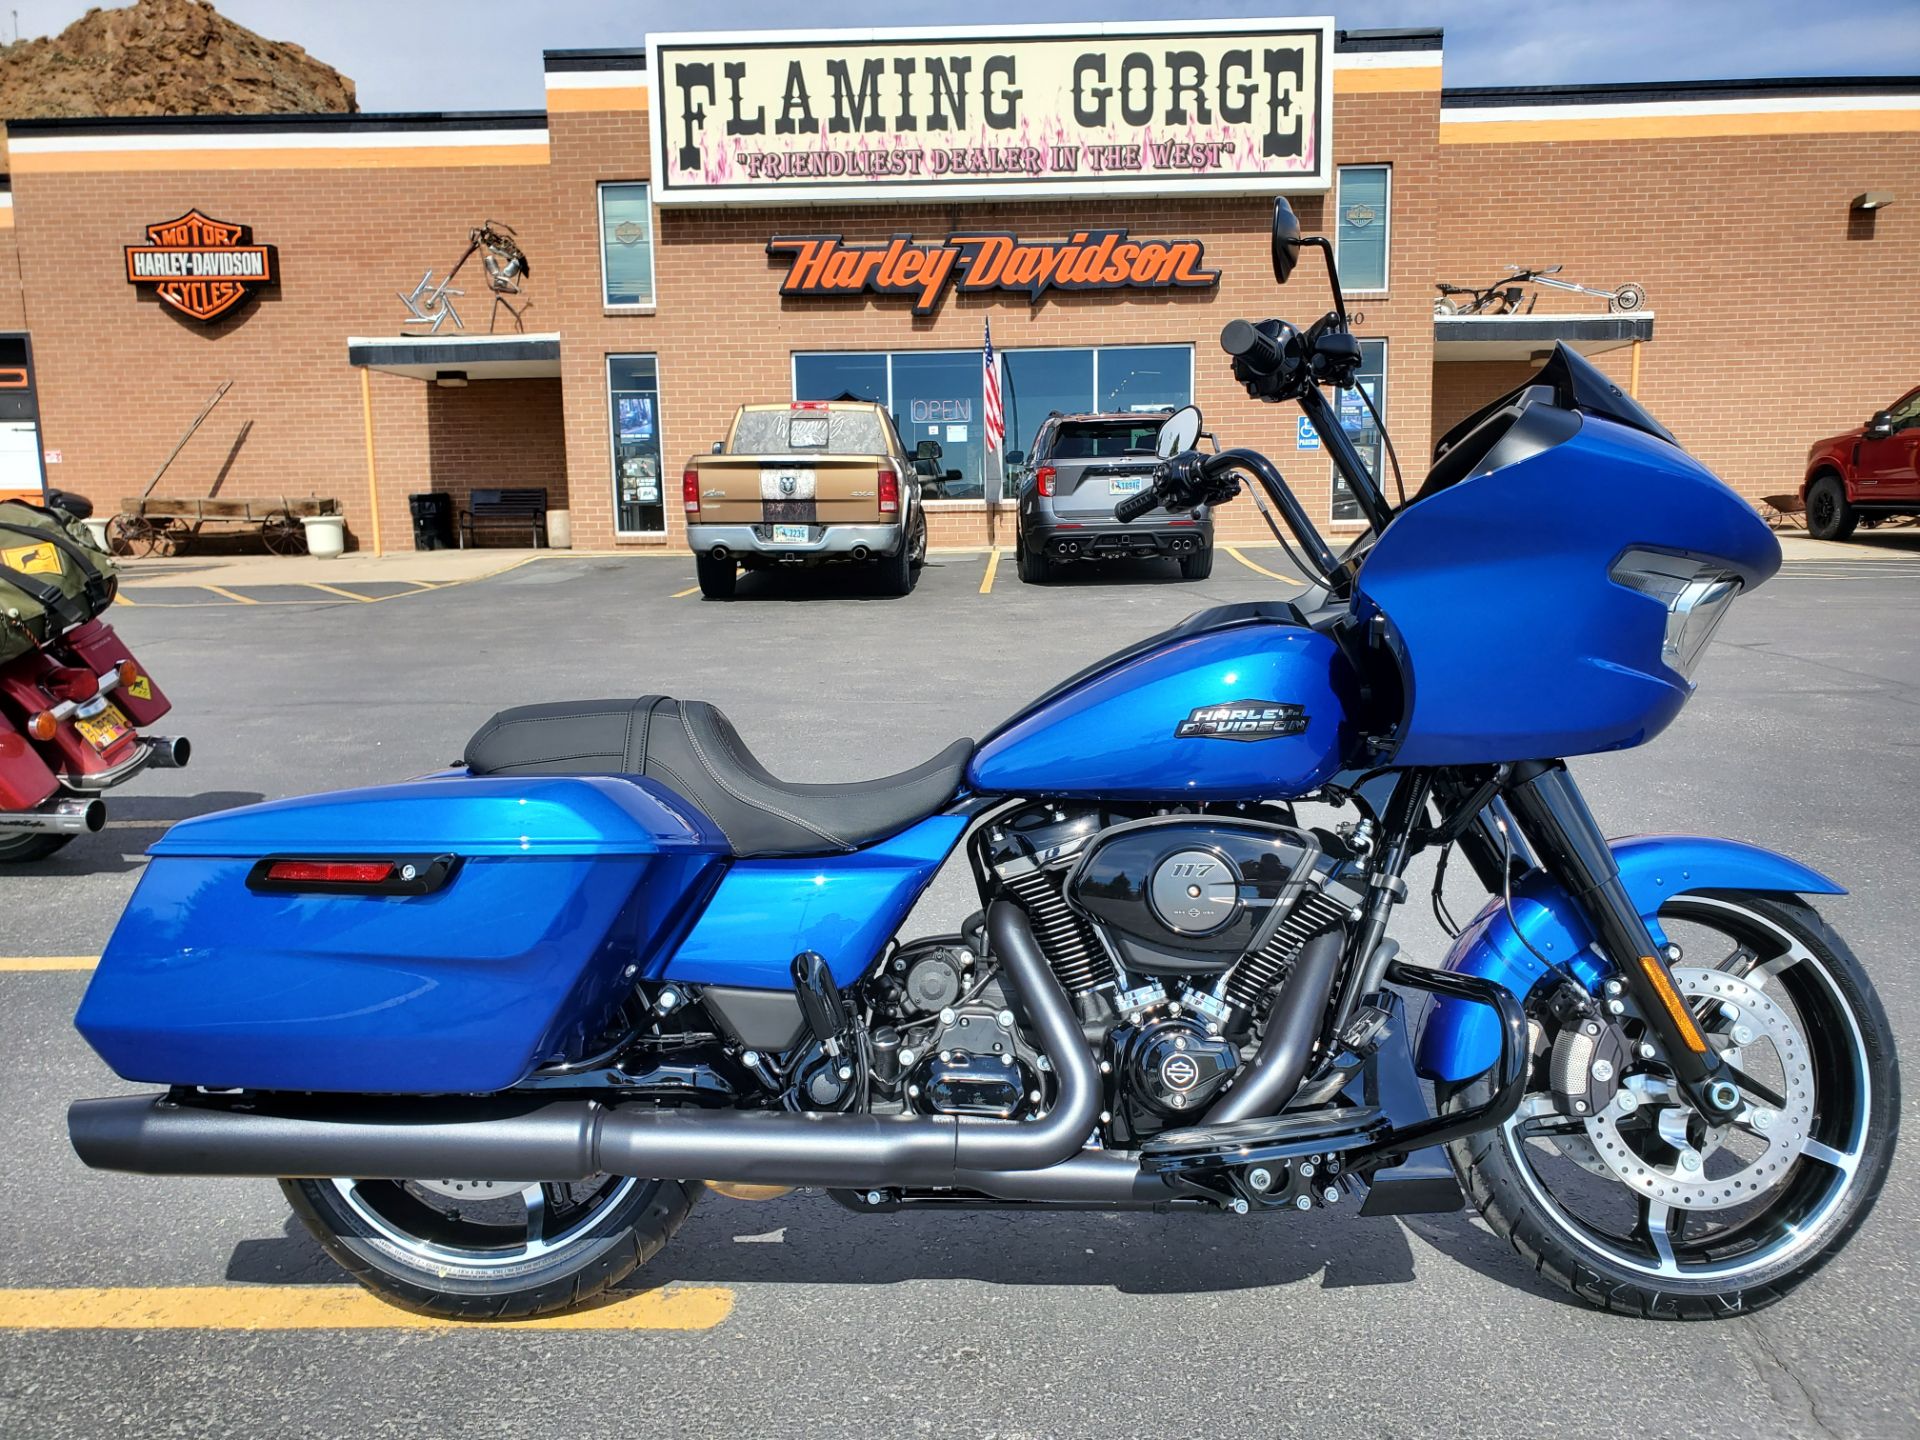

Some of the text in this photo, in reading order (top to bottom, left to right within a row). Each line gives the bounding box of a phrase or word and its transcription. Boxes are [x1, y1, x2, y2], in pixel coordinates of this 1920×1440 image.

[675, 48, 1304, 170] FLAMING GORGE
[737, 138, 1236, 180] "FRIENDLIEST DEALER IN THE WEST"
[162, 218, 230, 246] MOTOR
[134, 251, 263, 276] HARLEY-DAVIDSON
[771, 232, 1216, 308] Harley-Davidson
[167, 282, 234, 313] CYCLES
[913, 400, 969, 420] OPEN
[1180, 719, 1305, 734] DAVIDSON
[1193, 707, 1300, 722] HARLEY-
[1171, 863, 1217, 877] 117
